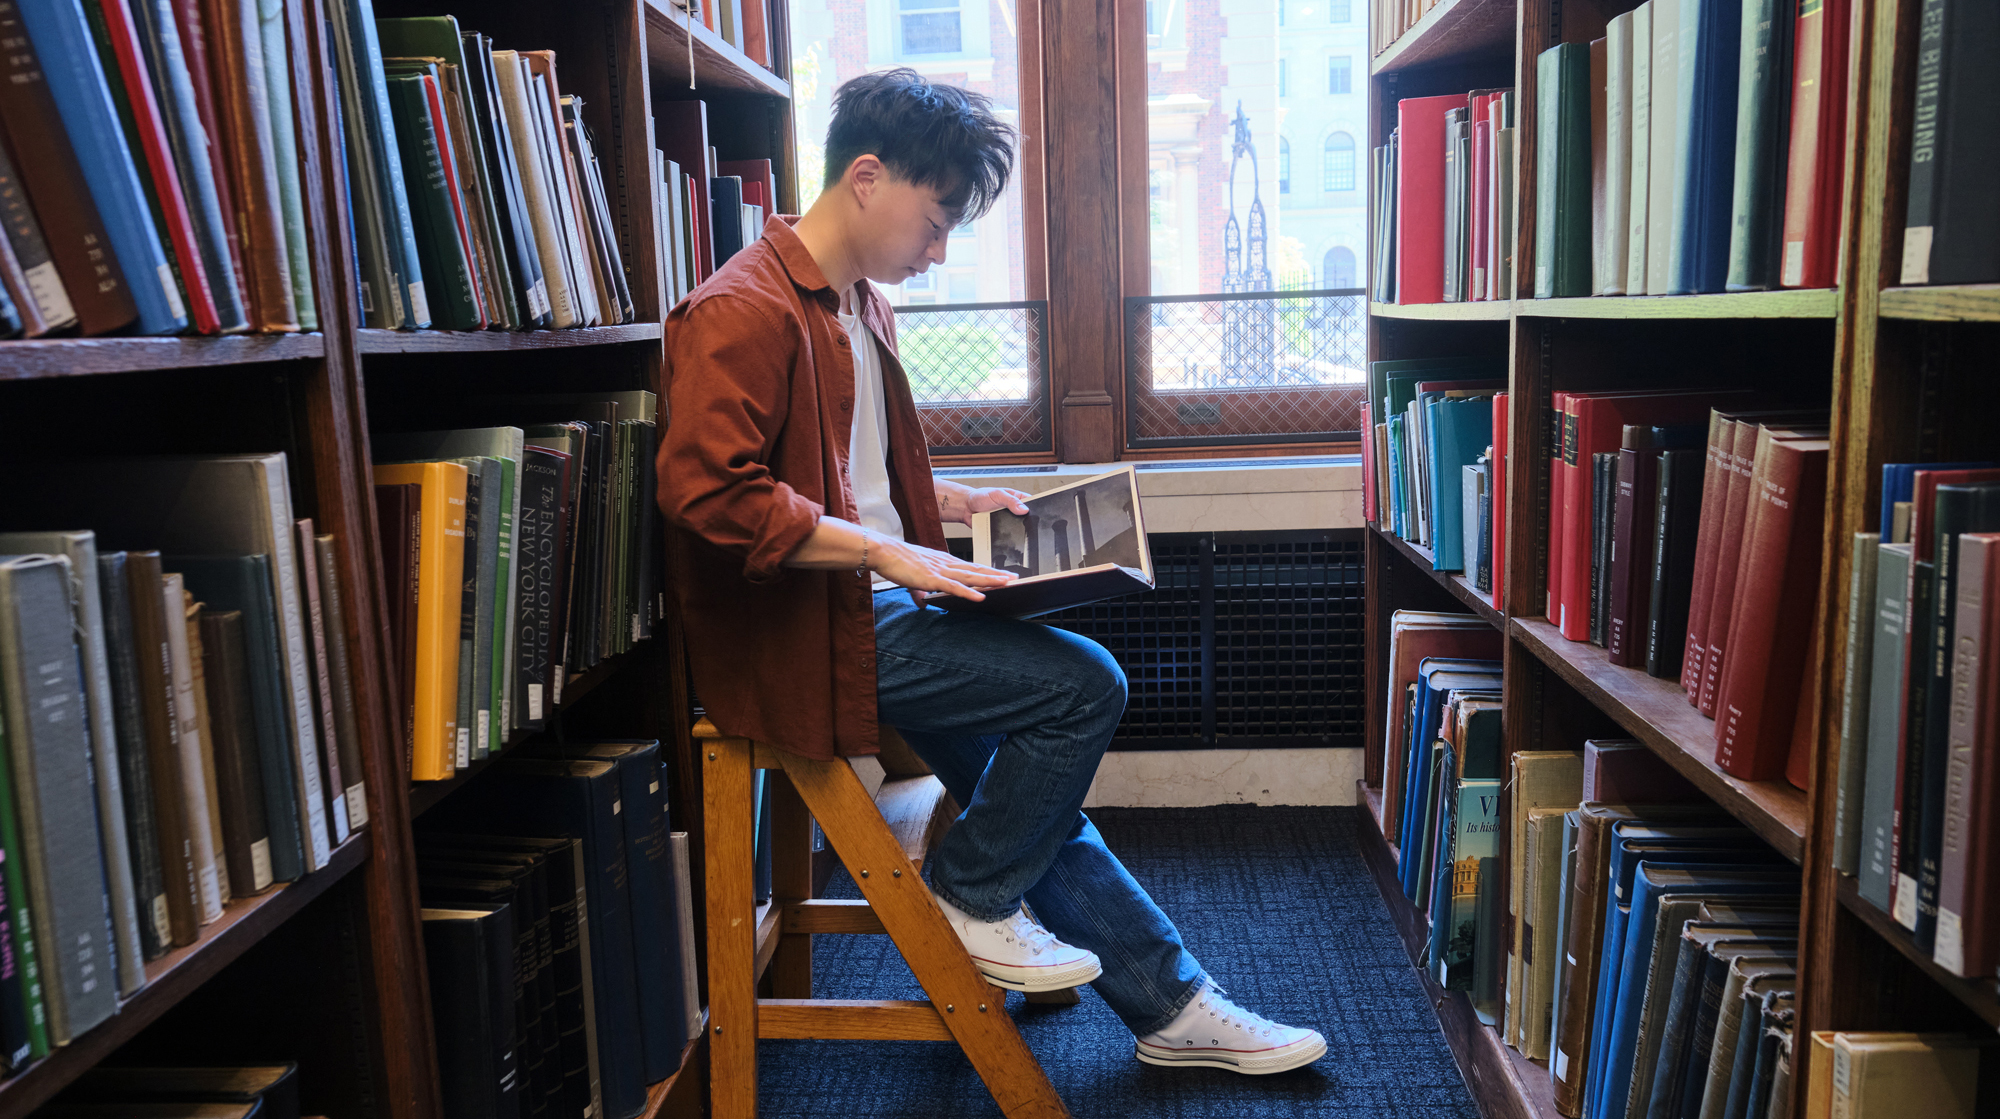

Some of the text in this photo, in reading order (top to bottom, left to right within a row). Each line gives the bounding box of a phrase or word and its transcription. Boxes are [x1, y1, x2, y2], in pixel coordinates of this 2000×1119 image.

[1913, 49, 1941, 163] BUILDING
[371, 47, 412, 244] PICTURING NEW YORK
[1736, 455, 1747, 466] TALES
[526, 463, 557, 476] JACKSON
[1620, 480, 1632, 489] SUBWAY
[1766, 480, 1786, 495] TALES OF
[1621, 489, 1630, 497] STYLE
[1761, 490, 1788, 509] FIVE POINTS
[466, 527, 476, 540] By
[275, 507, 300, 640] MANHATTAN
[535, 485, 554, 684] The ENCYCLOPEDIA of
[521, 507, 536, 676] NEW YORK CITY
[311, 600, 323, 639] NEW
[1590, 617, 1596, 628] AA
[1613, 618, 1623, 626] AVERY
[1695, 643, 1705, 654] Avery
[1710, 644, 1722, 655] Avery
[316, 648, 331, 704] YORK
[1729, 704, 1742, 717] Avery
[1730, 717, 1736, 725] AA
[1943, 636, 1978, 854] Gracie Mansion
[1466, 822, 1478, 833] Its
[1923, 858, 1936, 871] AA
